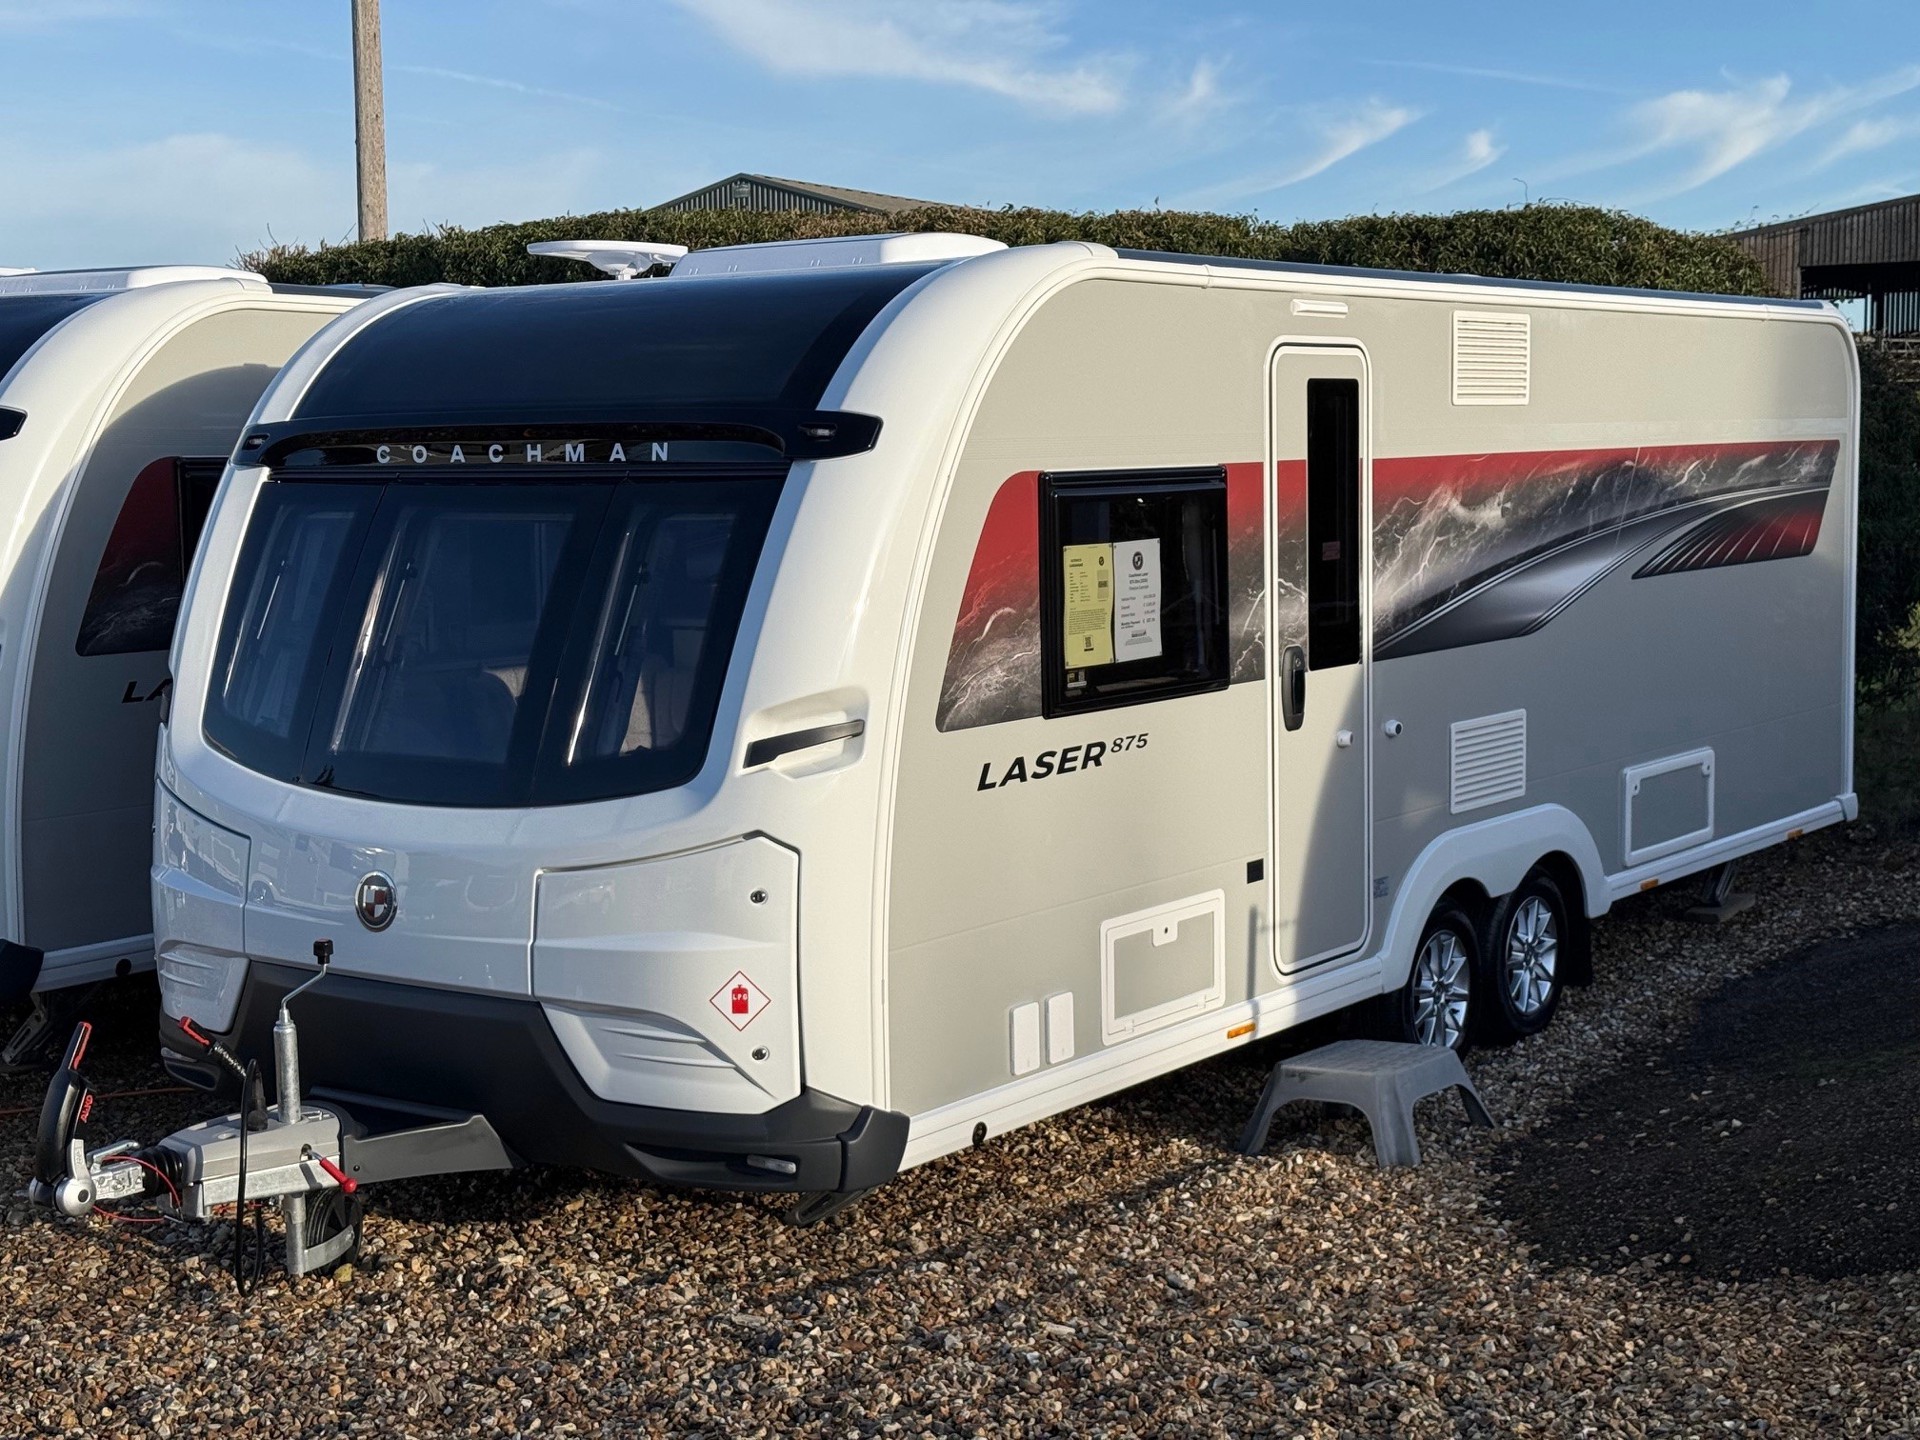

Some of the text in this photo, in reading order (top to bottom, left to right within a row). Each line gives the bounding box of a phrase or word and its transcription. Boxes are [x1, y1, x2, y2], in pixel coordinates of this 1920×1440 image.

[376, 442, 669, 464] COACHMAN
[977, 732, 1149, 791] LASER 875
